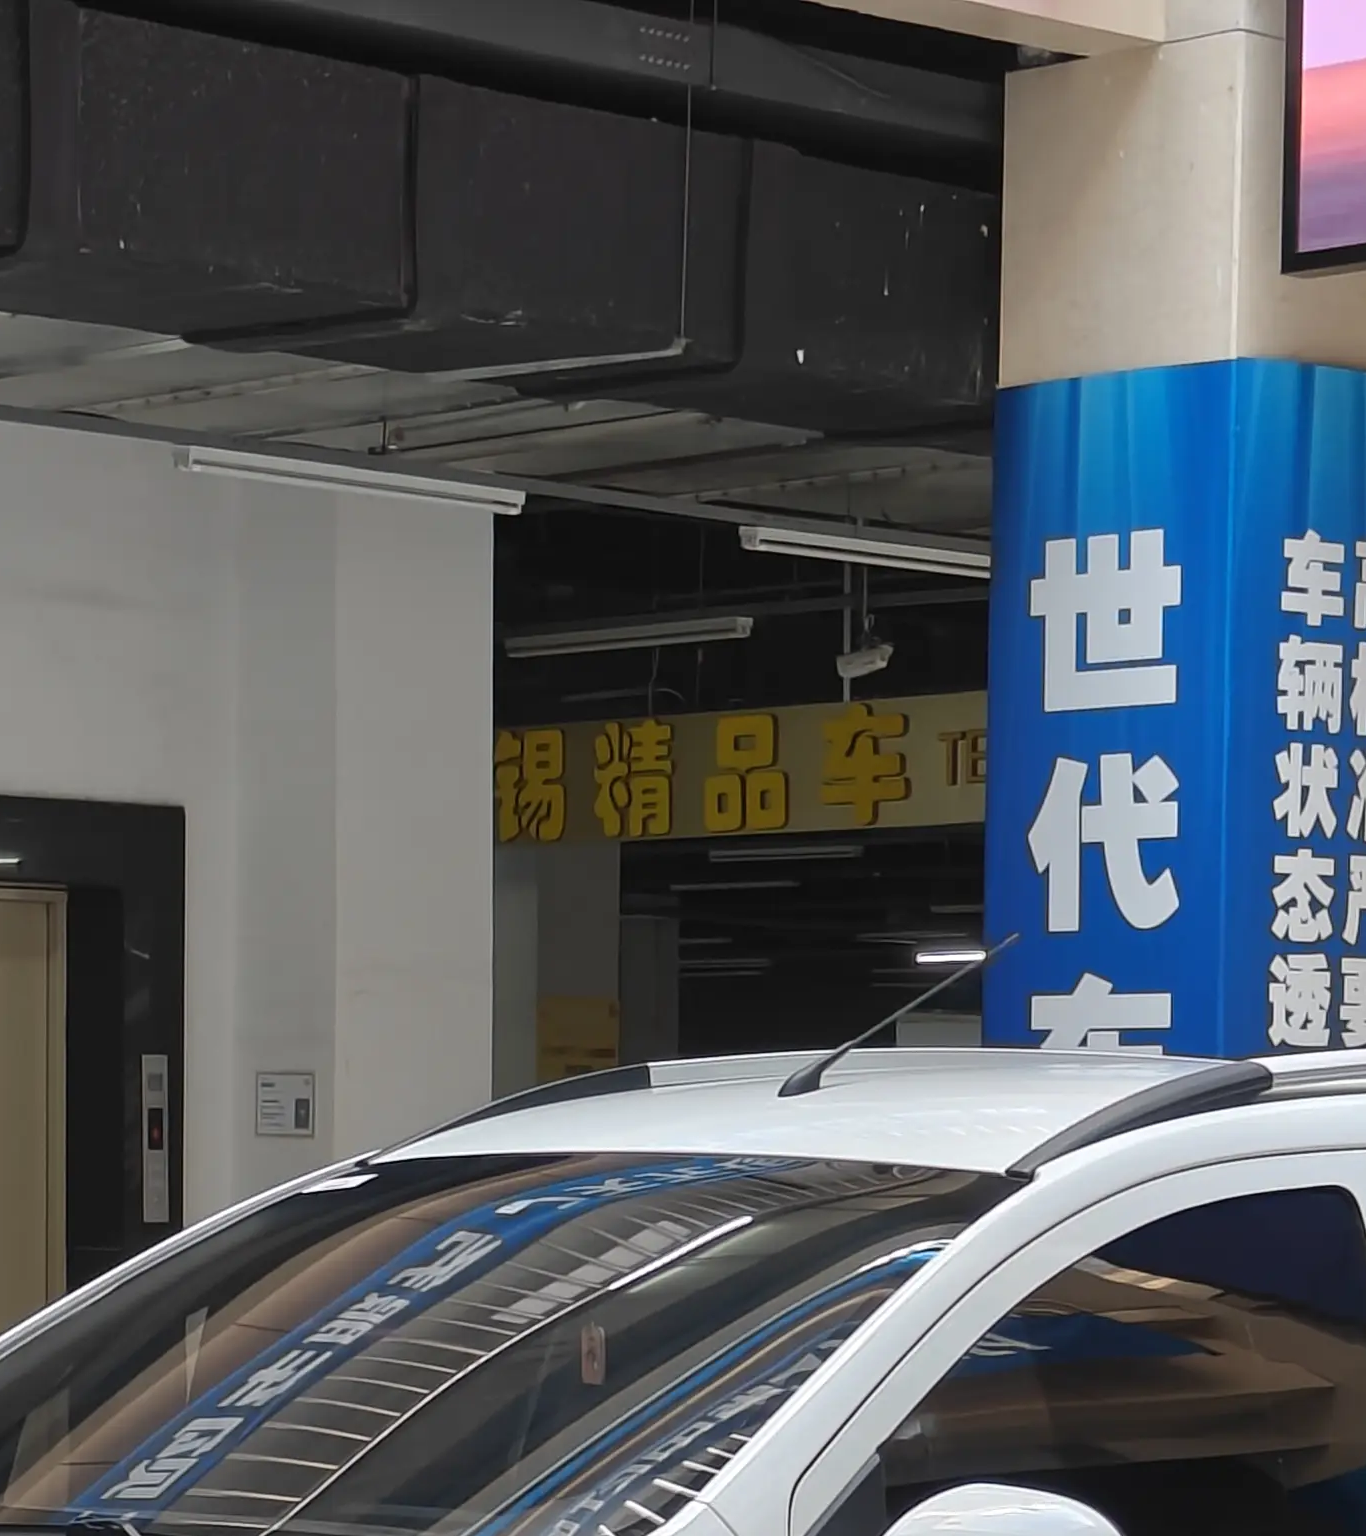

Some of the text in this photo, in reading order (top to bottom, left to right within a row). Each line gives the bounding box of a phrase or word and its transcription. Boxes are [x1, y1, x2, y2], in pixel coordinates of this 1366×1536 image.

[494, 703, 911, 842] 锡精品车
[1268, 529, 1346, 1048] 车辆状态透
